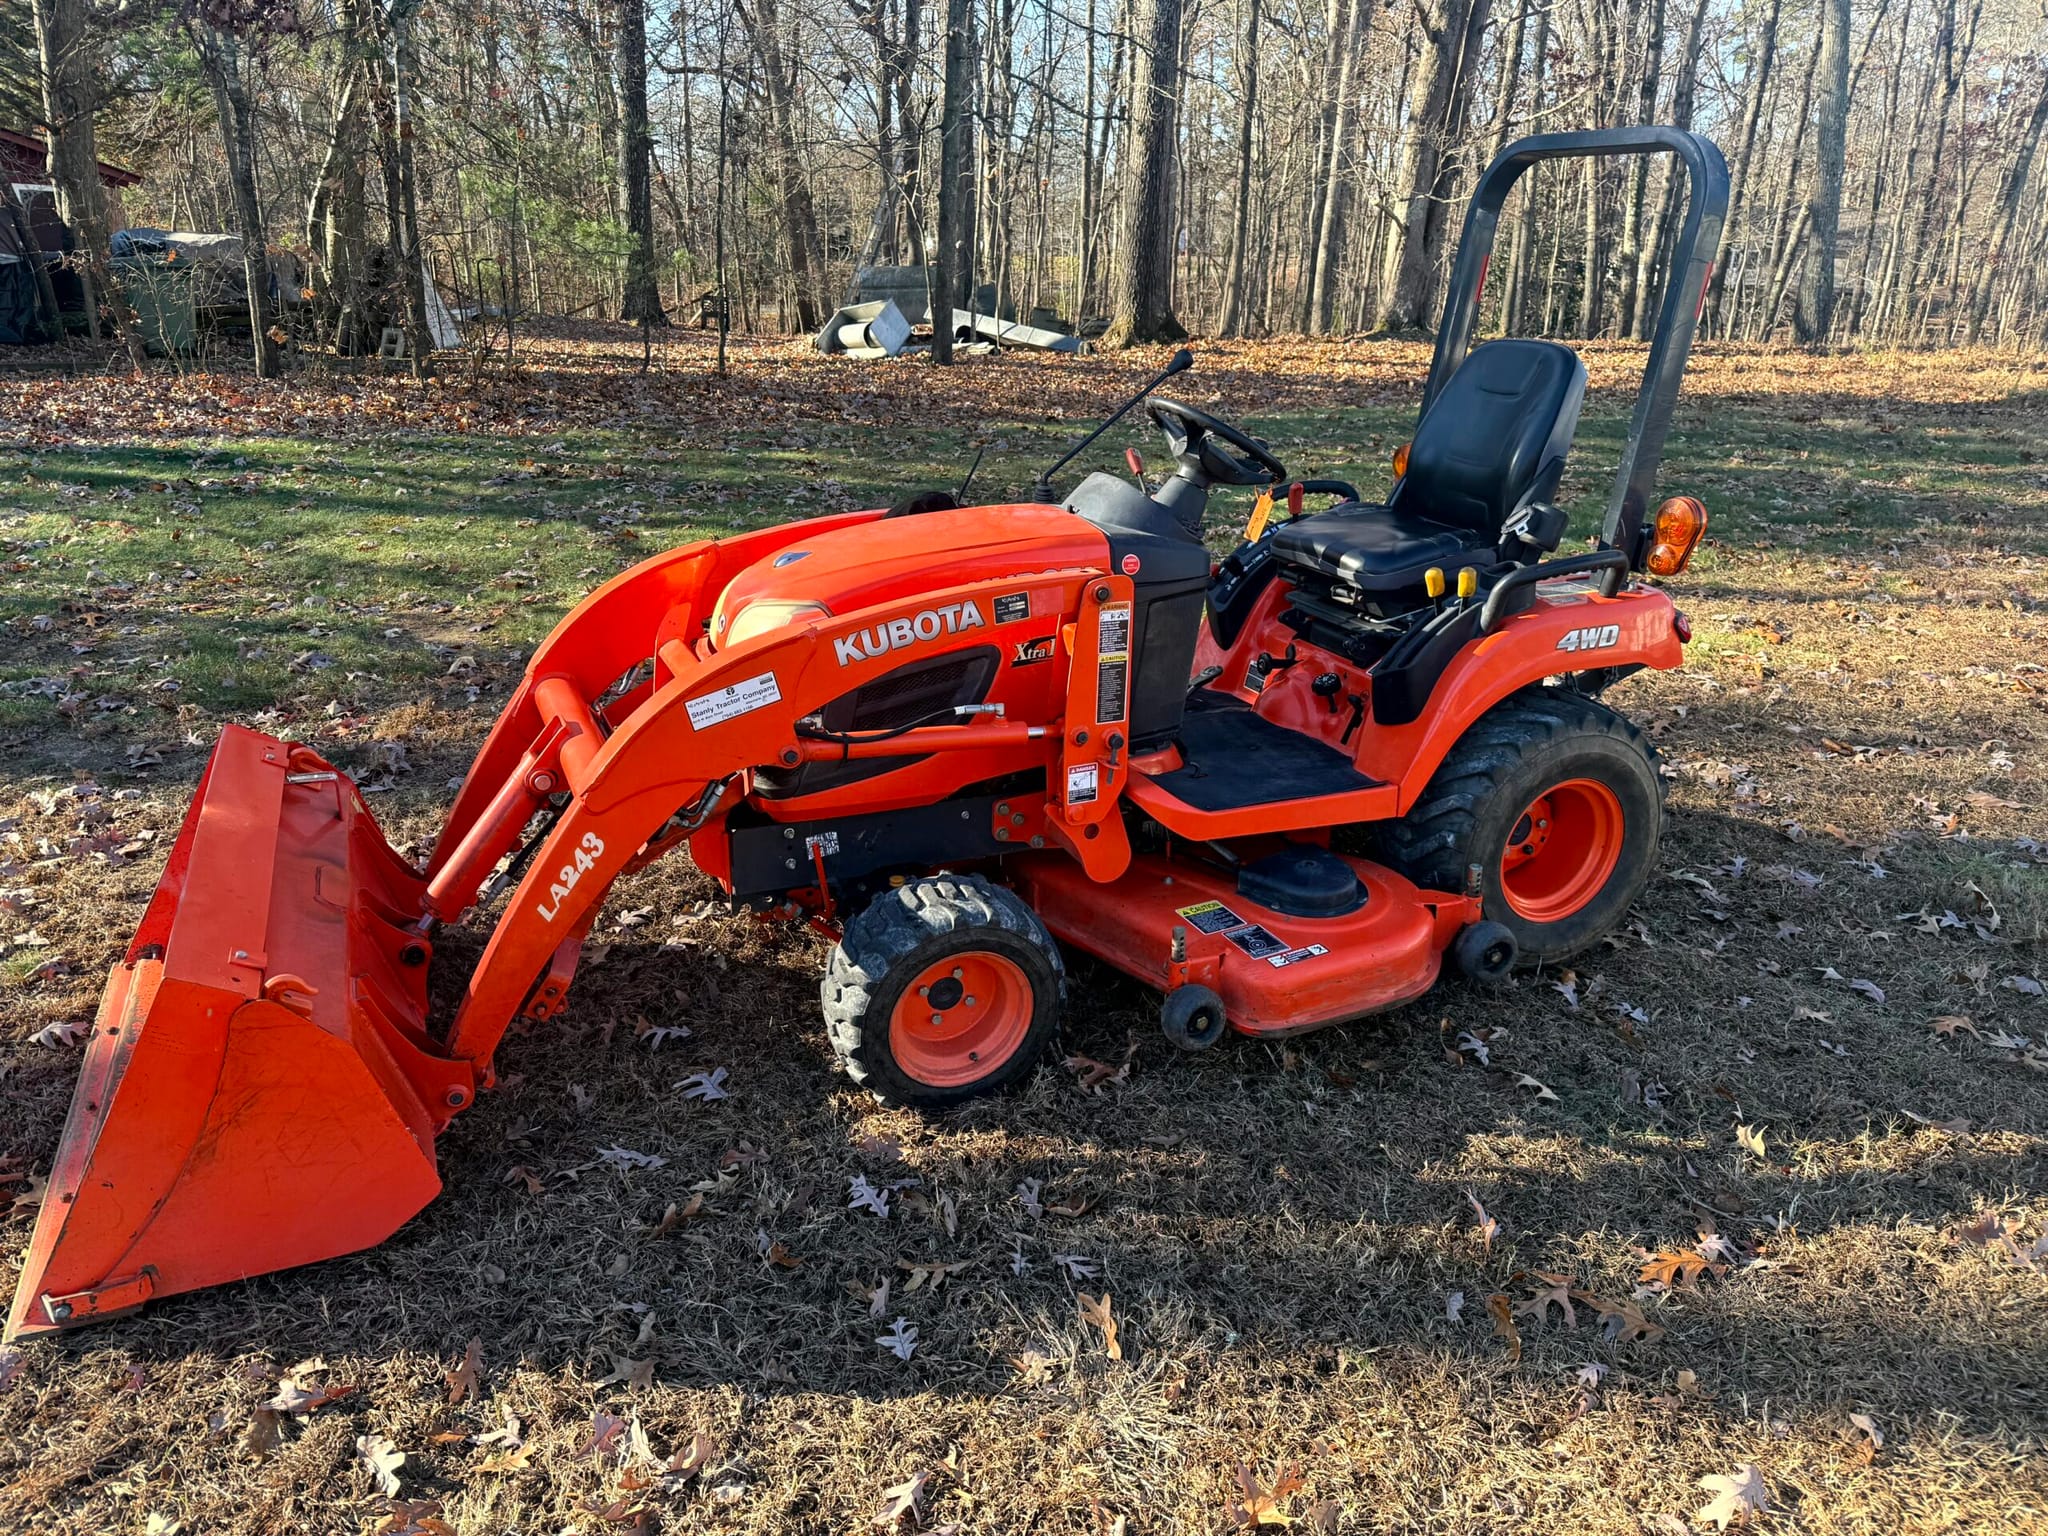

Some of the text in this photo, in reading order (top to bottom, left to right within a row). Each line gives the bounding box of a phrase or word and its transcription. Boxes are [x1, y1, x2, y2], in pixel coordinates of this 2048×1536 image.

[833, 600, 985, 667] KUBOTA
[1555, 624, 1620, 652] 4WD
[691, 705, 714, 719] Stanly
[716, 697, 741, 710] Tractor
[742, 685, 776, 700] Company
[537, 832, 604, 922] LA243
[1190, 902, 1220, 912] CAUTION
